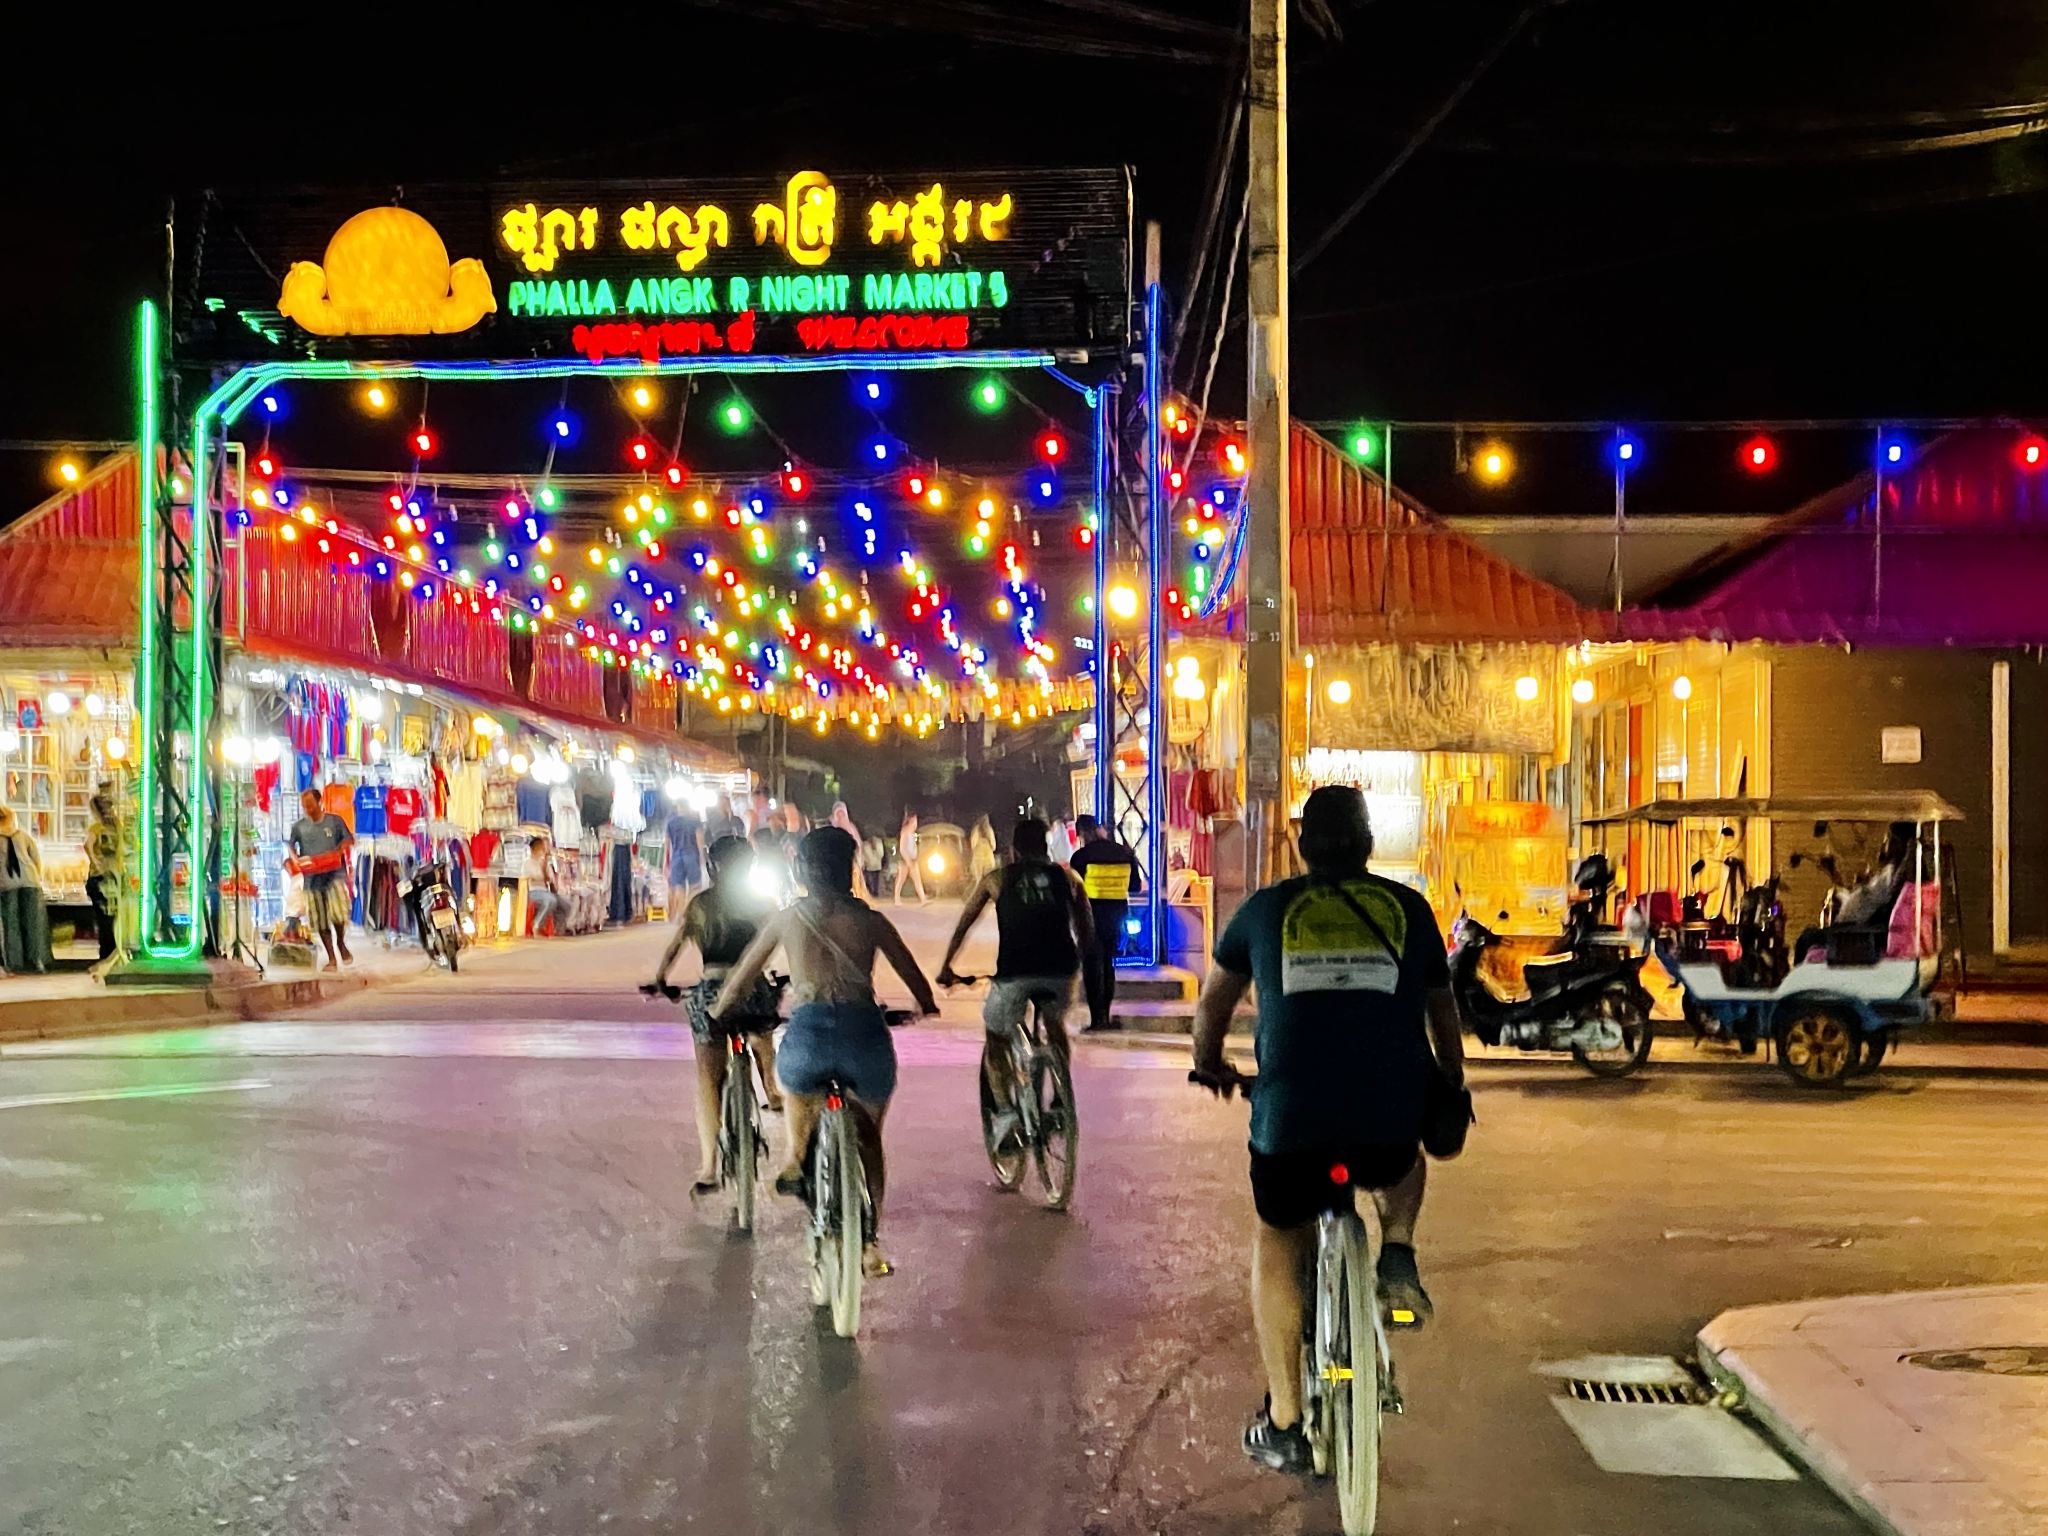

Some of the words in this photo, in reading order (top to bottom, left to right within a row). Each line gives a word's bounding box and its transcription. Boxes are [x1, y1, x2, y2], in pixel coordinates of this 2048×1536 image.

[509, 279, 617, 316] PHALLA
[624, 277, 751, 313] ANGKR
[761, 275, 850, 311] NIGHT
[864, 272, 982, 309] MARKET
[797, 314, 969, 350] WELCOME
